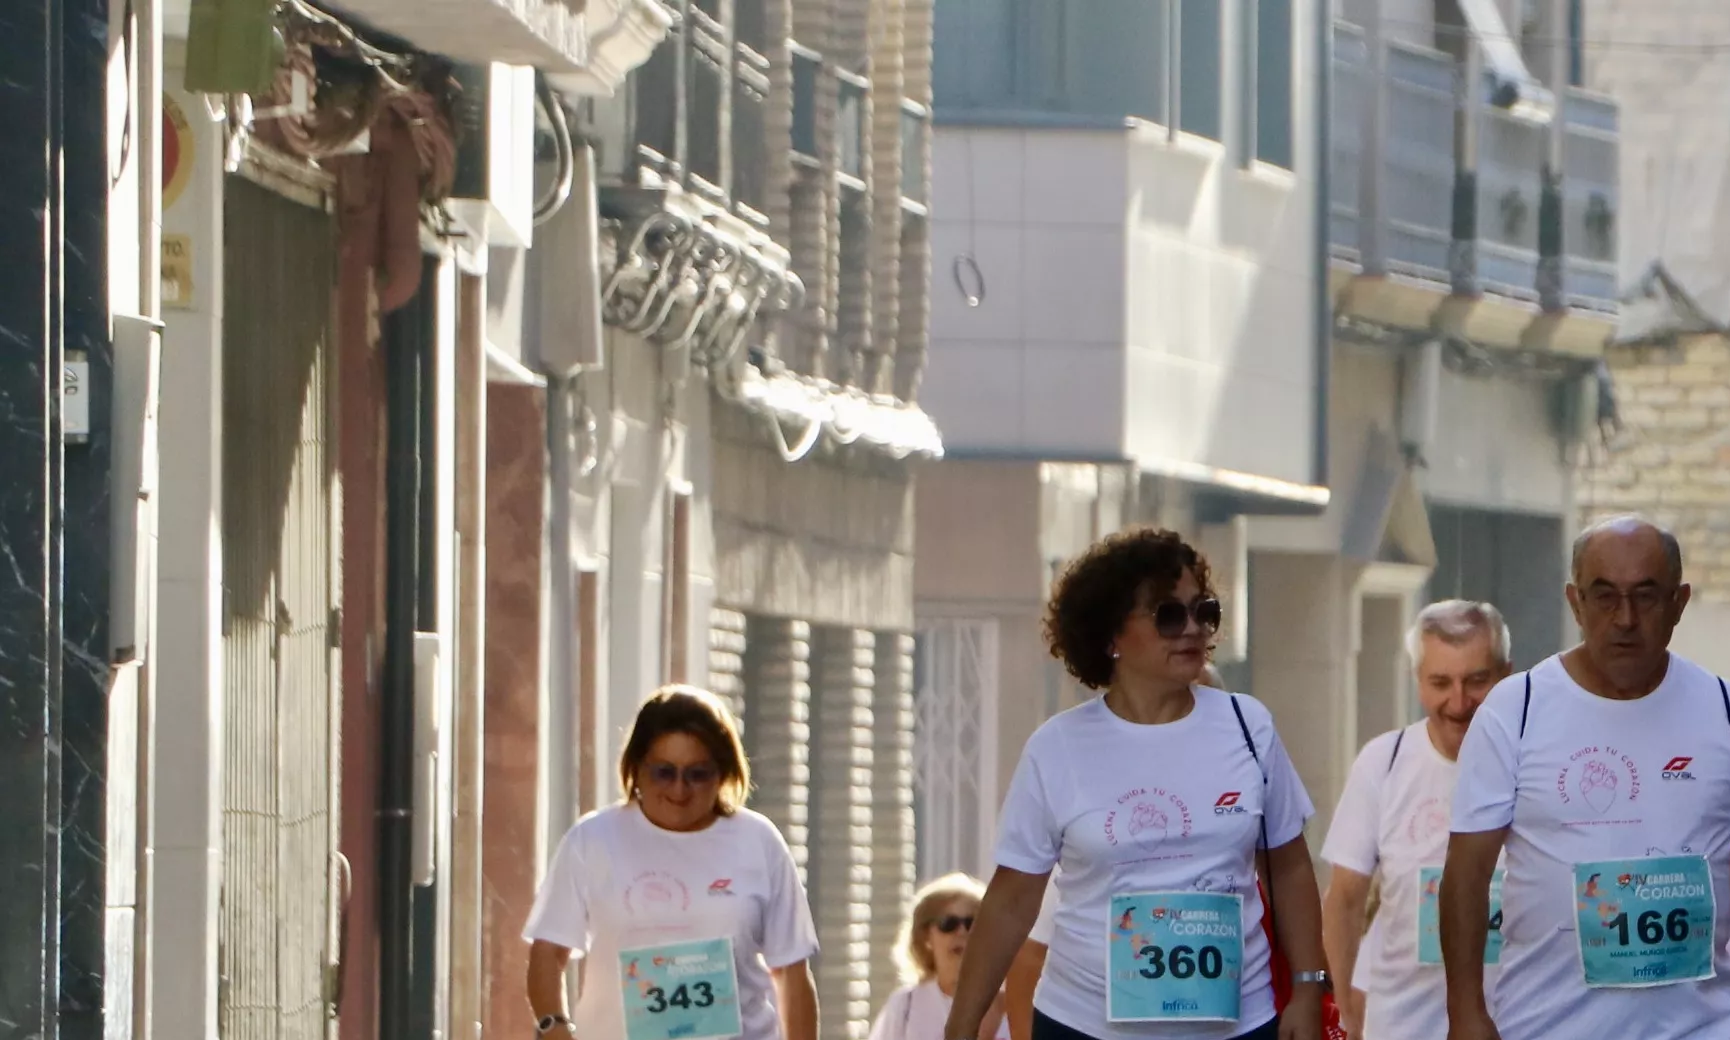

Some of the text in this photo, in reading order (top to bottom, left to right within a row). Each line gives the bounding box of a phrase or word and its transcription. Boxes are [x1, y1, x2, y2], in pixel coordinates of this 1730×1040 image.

[1569, 746, 1599, 762] CUIDA
[1605, 746, 1618, 756] TU
[1117, 788, 1147, 804] CUIDA
[1153, 788, 1166, 796] TU
[1609, 907, 1690, 946] 166
[1139, 945, 1223, 979] 360
[646, 981, 715, 1014] 343
